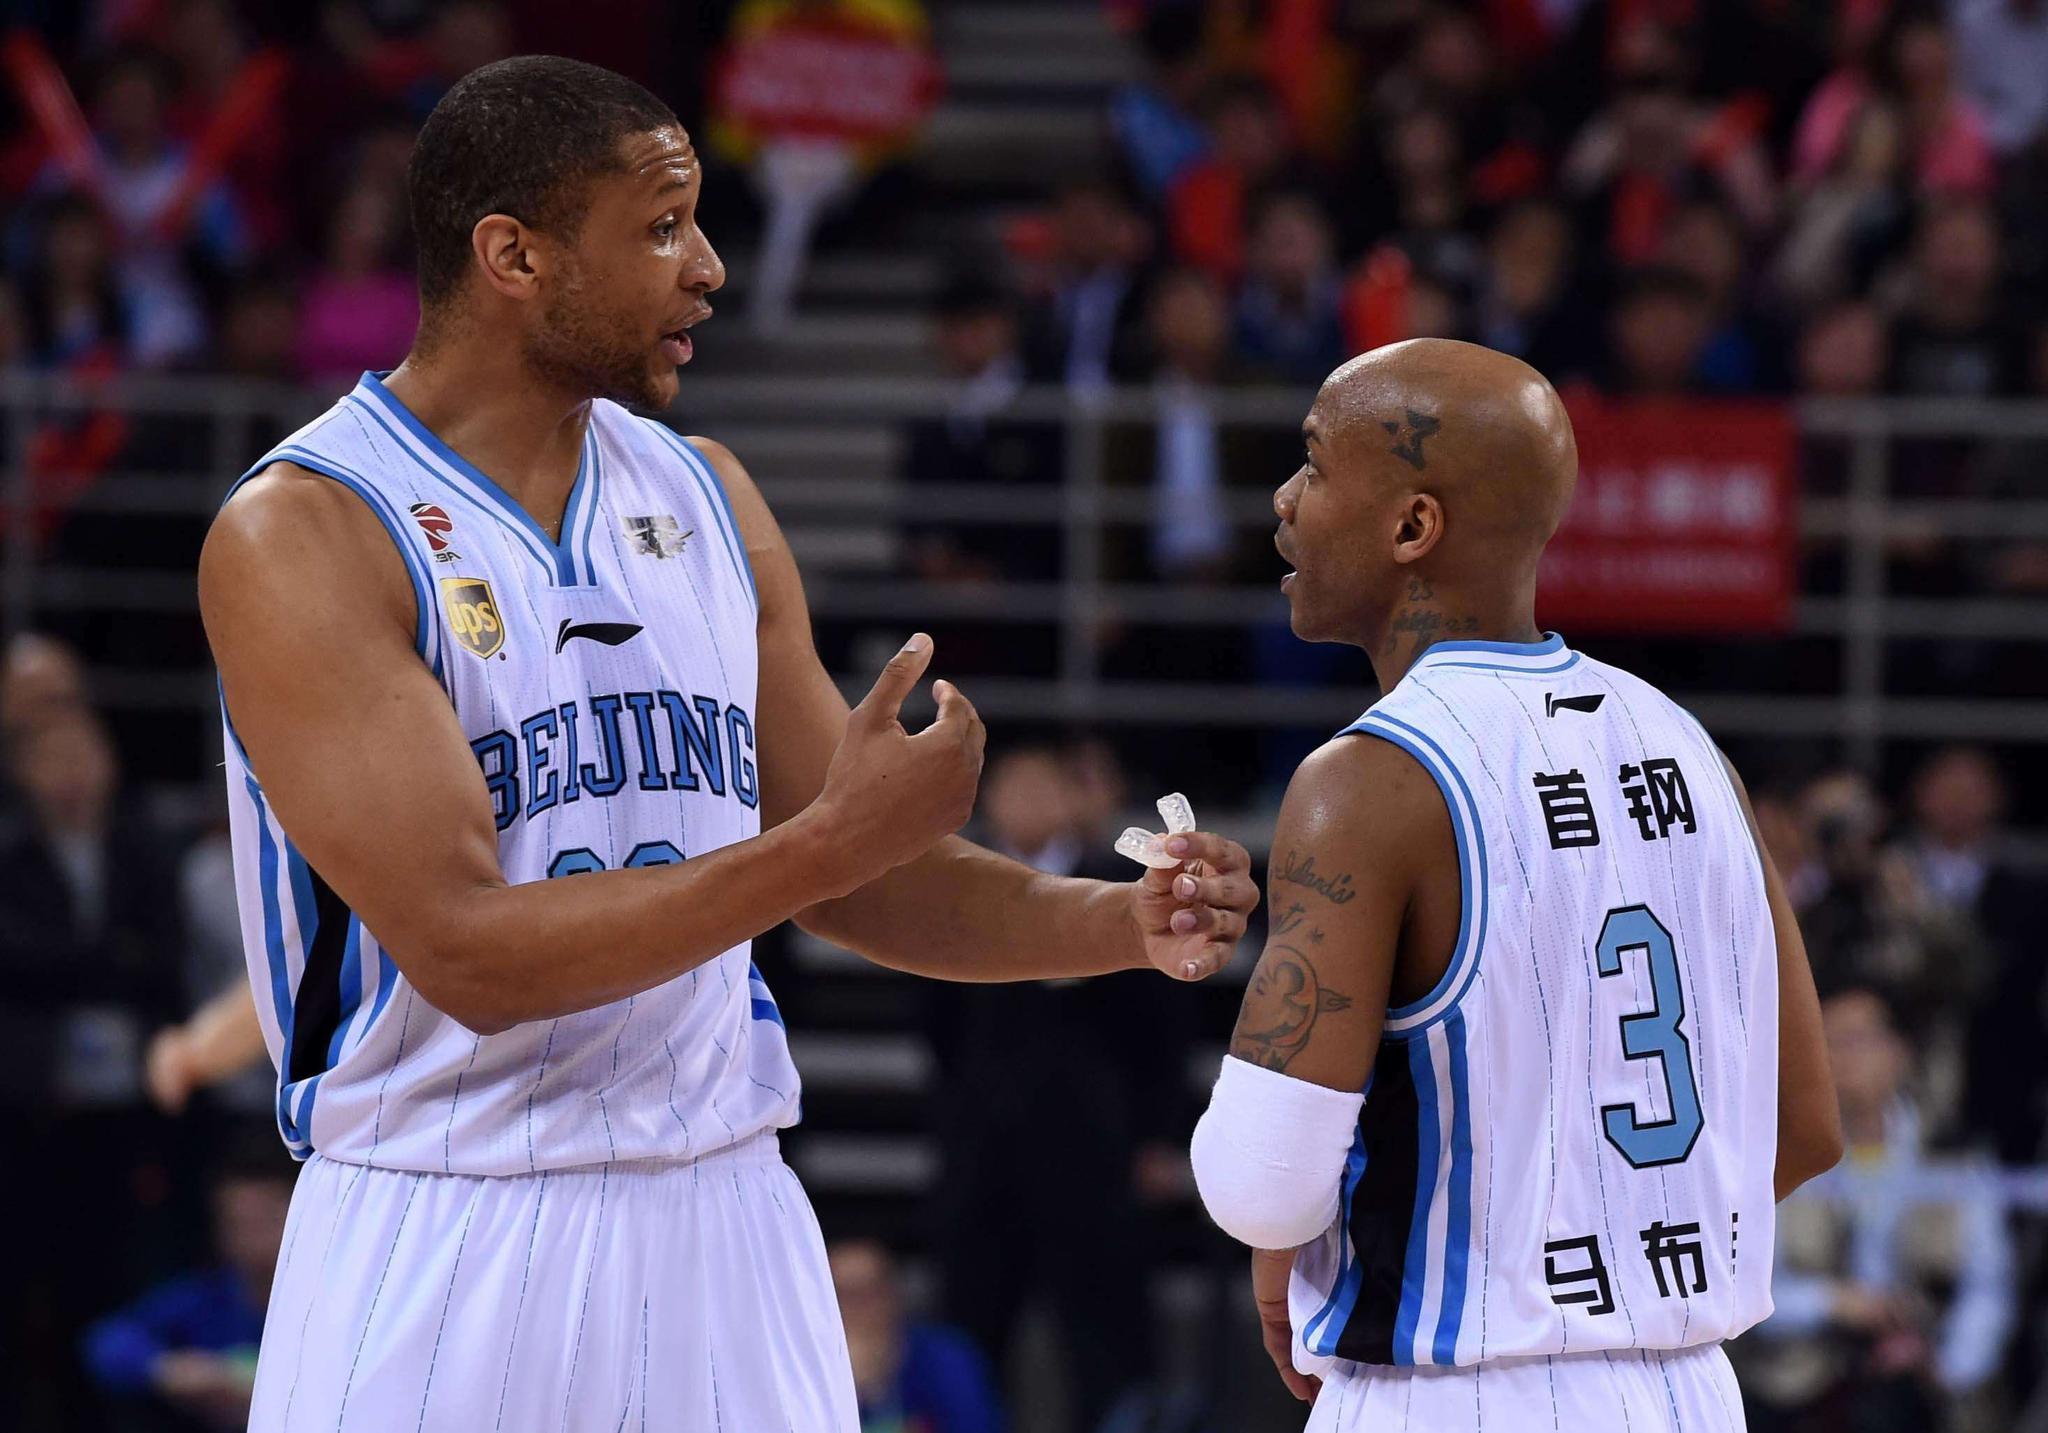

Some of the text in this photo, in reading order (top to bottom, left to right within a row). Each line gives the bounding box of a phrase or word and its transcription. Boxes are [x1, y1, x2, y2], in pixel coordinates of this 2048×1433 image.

[447, 602, 498, 646] ups
[470, 689, 759, 832] BEIJING
[1533, 758, 1697, 850] 首钢
[1596, 903, 1704, 1169] 3
[1544, 1212, 1738, 1316] 马布
